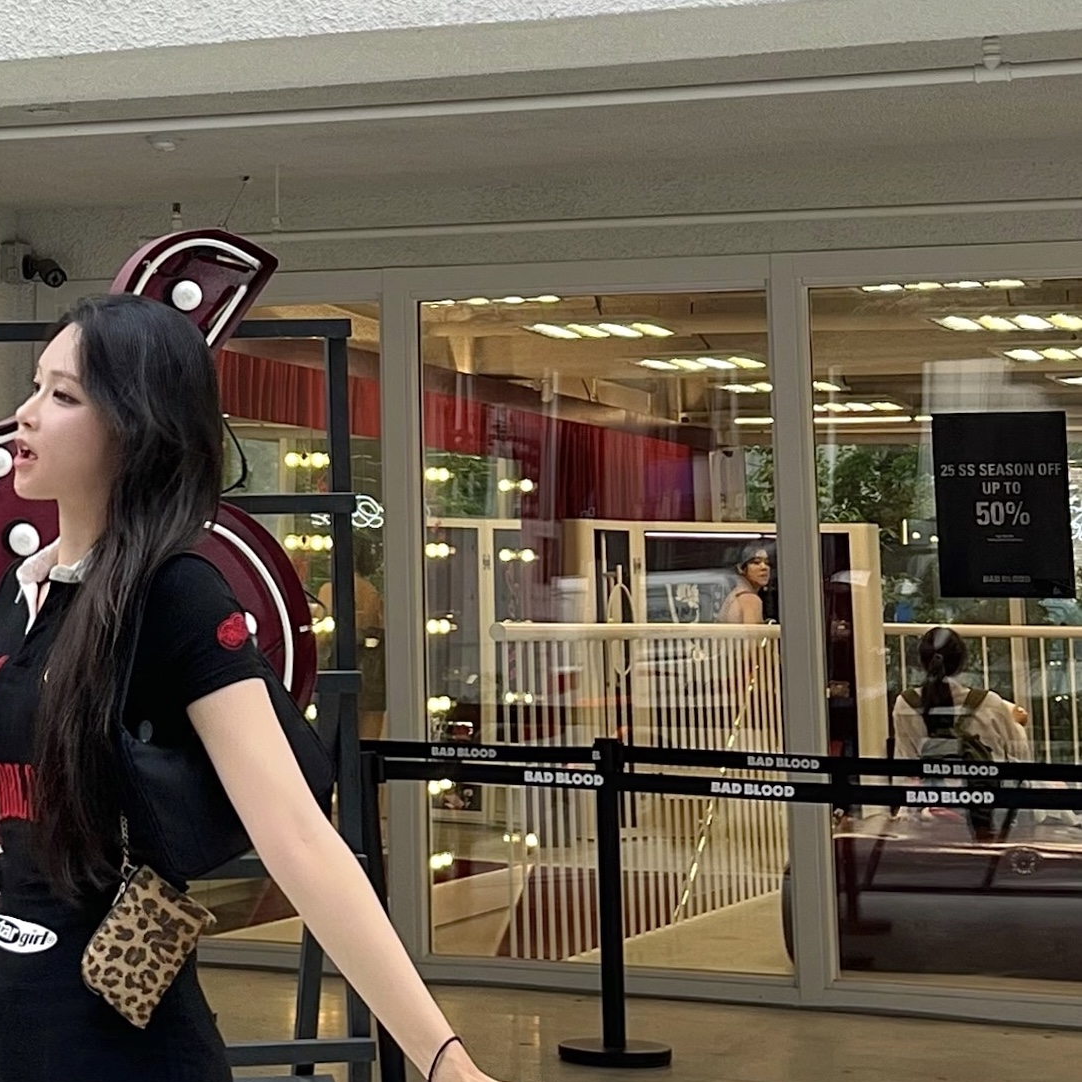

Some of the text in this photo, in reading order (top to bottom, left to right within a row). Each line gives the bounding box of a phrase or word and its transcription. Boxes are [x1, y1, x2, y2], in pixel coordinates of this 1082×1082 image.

[940, 463, 1062, 477] 25 SS SEASON OFF
[982, 481, 1021, 495] UP TO
[975, 501, 1031, 526] 50%
[431, 746, 497, 758] BAD BLOOD
[747, 756, 820, 769] BAD BLOOD
[923, 763, 999, 776] BAD BLOOD
[524, 771, 604, 786] BAD BLOOD
[710, 782, 795, 797] BAD BLOOD
[906, 790, 995, 804] BAD BLOOD
[18, 929, 50, 947] girl
